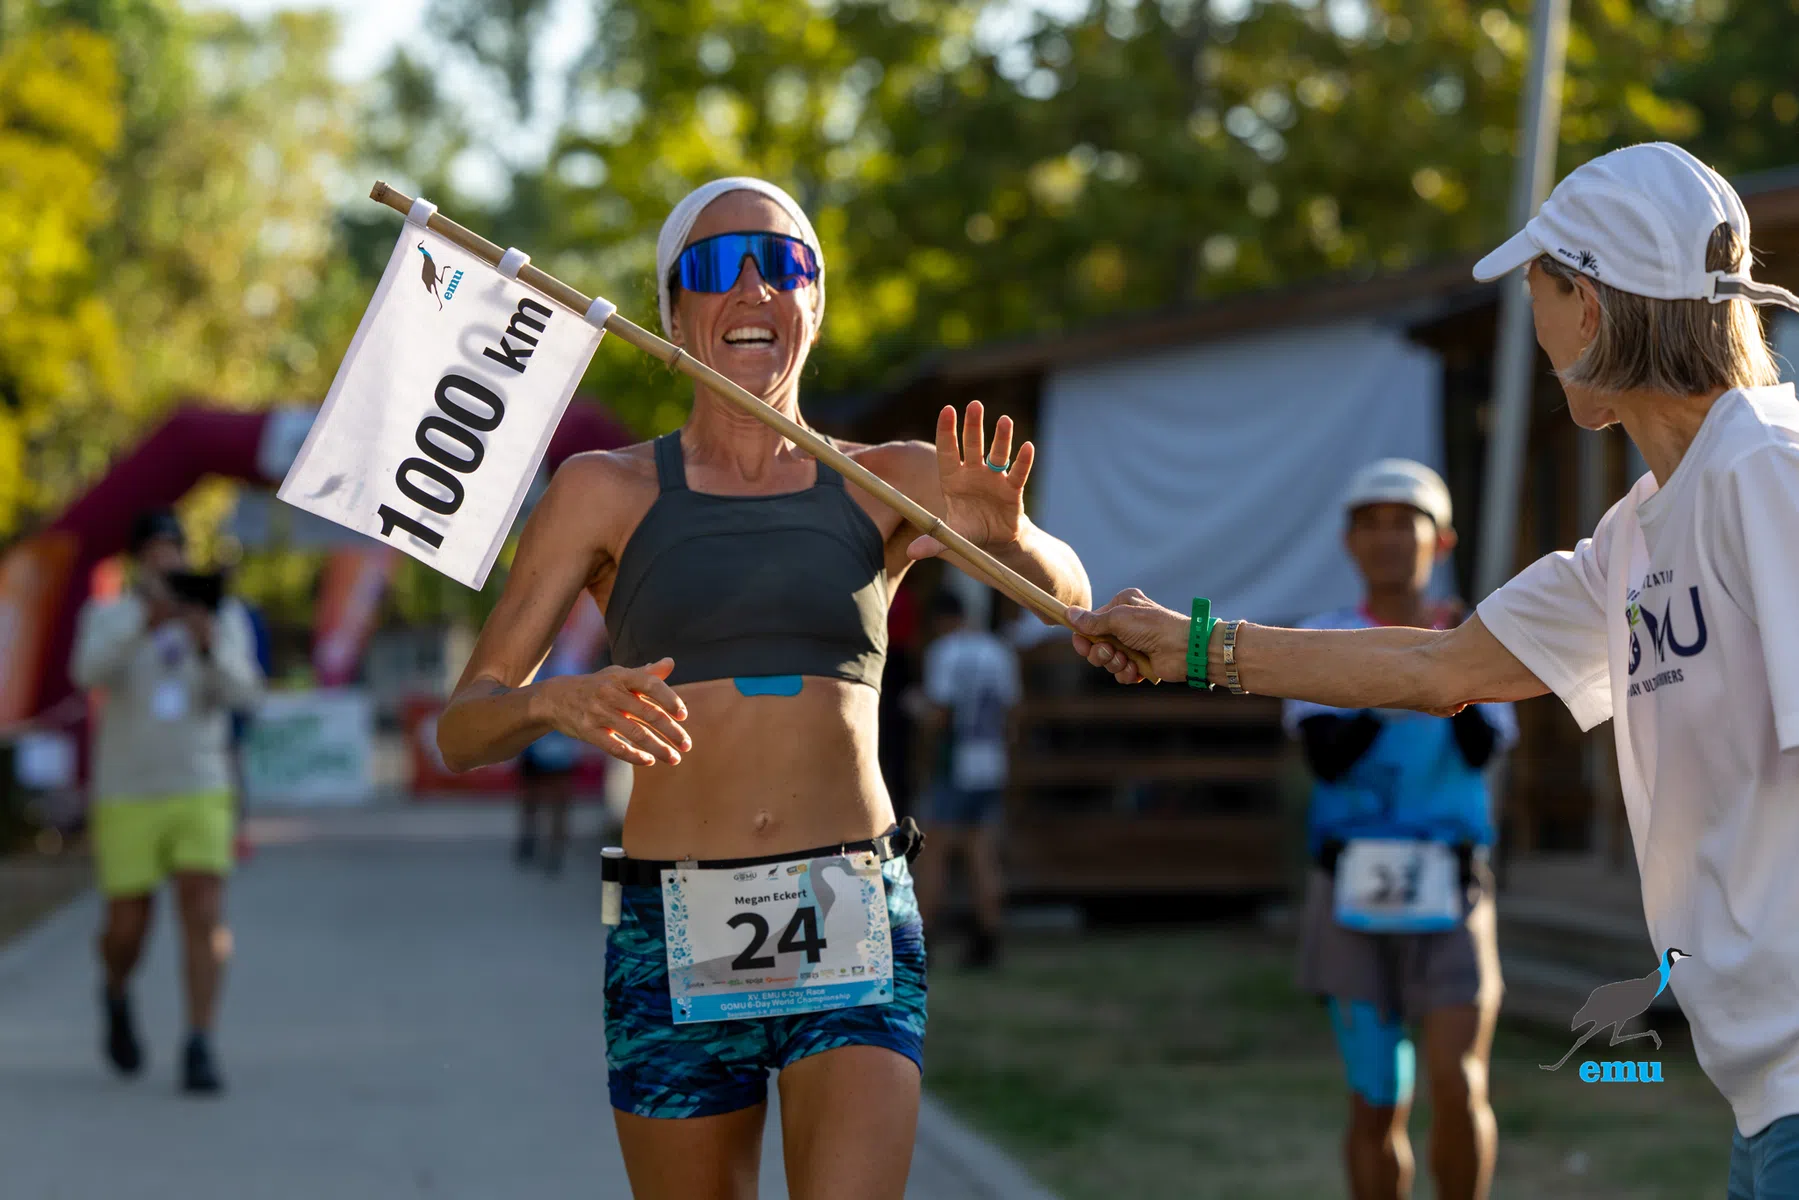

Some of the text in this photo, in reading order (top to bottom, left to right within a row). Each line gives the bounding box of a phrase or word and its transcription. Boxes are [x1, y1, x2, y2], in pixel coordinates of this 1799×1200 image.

[443, 269, 464, 301] emu
[377, 297, 553, 550] 1000 km
[734, 888, 807, 906] Megan Eckert
[726, 906, 827, 970] 24
[720, 1002, 746, 1011] GOMU
[747, 1000, 771, 1009] 6-Day
[796, 993, 851, 1004] Championship
[762, 991, 780, 1000] EMU
[781, 990, 804, 999] 6-Day
[806, 988, 825, 996] Race
